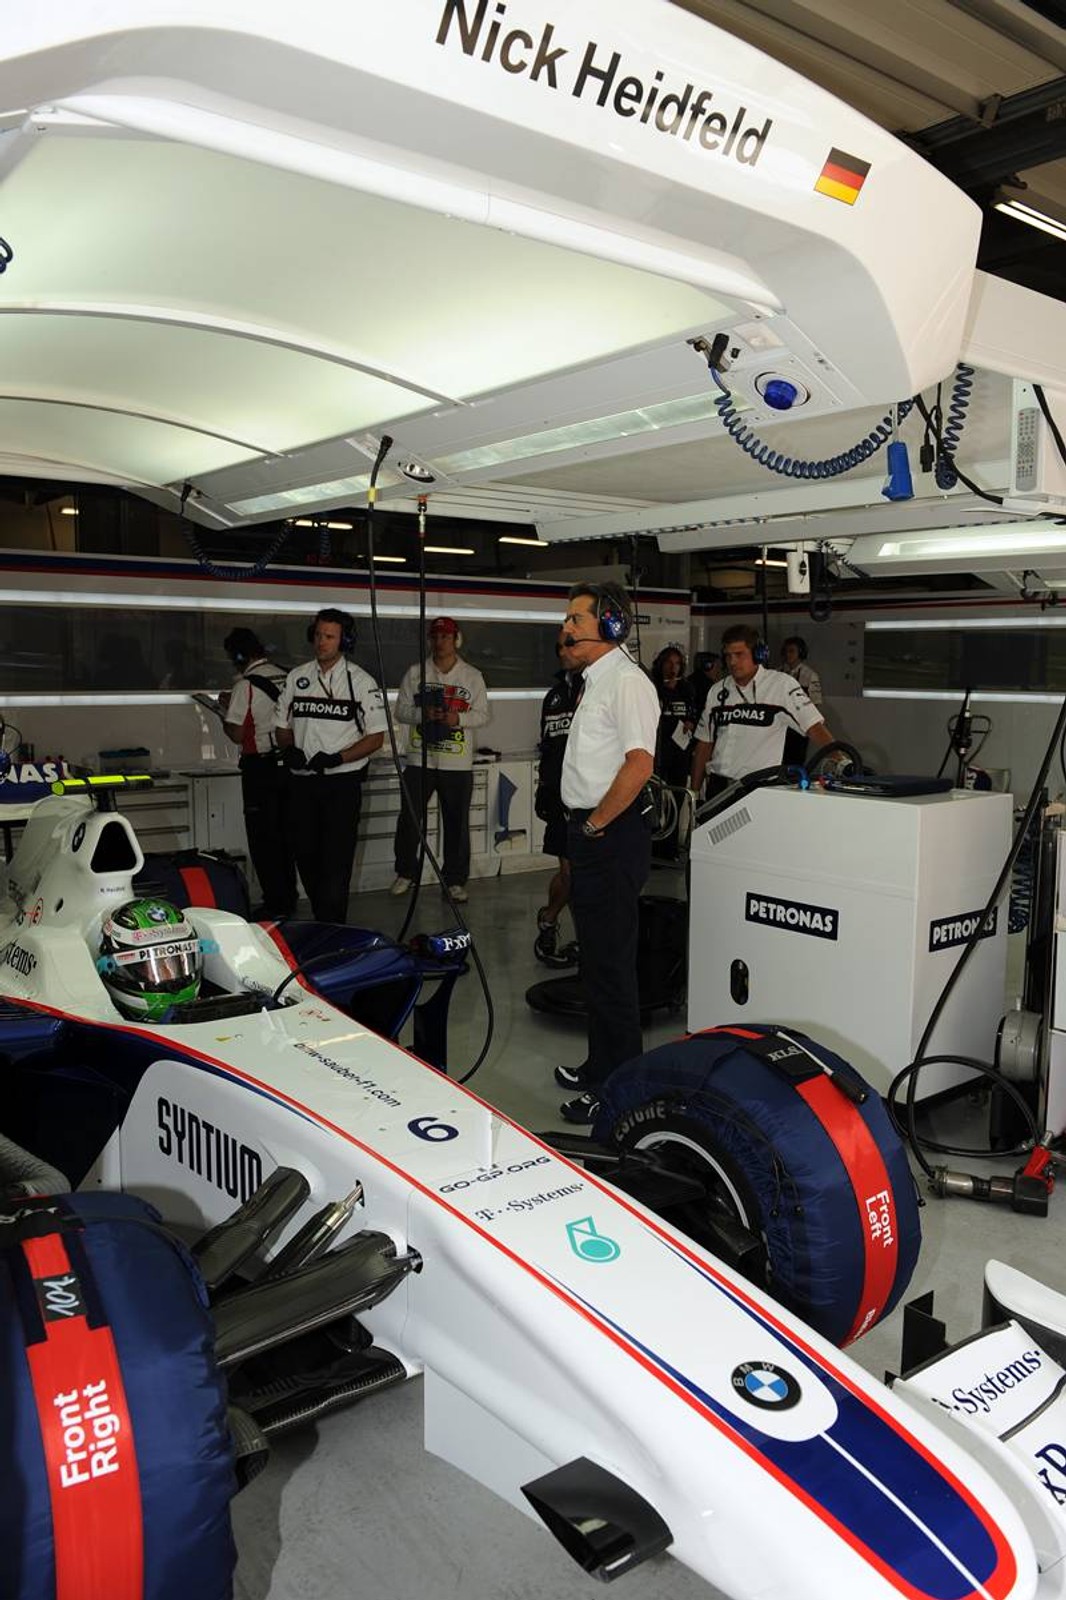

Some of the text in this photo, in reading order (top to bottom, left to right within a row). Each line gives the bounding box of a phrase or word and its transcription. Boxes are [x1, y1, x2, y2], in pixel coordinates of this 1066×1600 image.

[435, 0, 773, 167] Nick Heidfeld
[293, 702, 349, 717] PETRONAS
[749, 899, 834, 933] PETRONAS
[932, 912, 994, 945] PETRONS
[157, 1096, 263, 1205] SYNTIUM
[407, 1116, 460, 1142] 6
[865, 1195, 882, 1242] Left
[876, 1189, 894, 1249] Front
[732, 1362, 775, 1387] BMW
[53, 1388, 90, 1489] Front
[82, 1378, 120, 1479] Right
